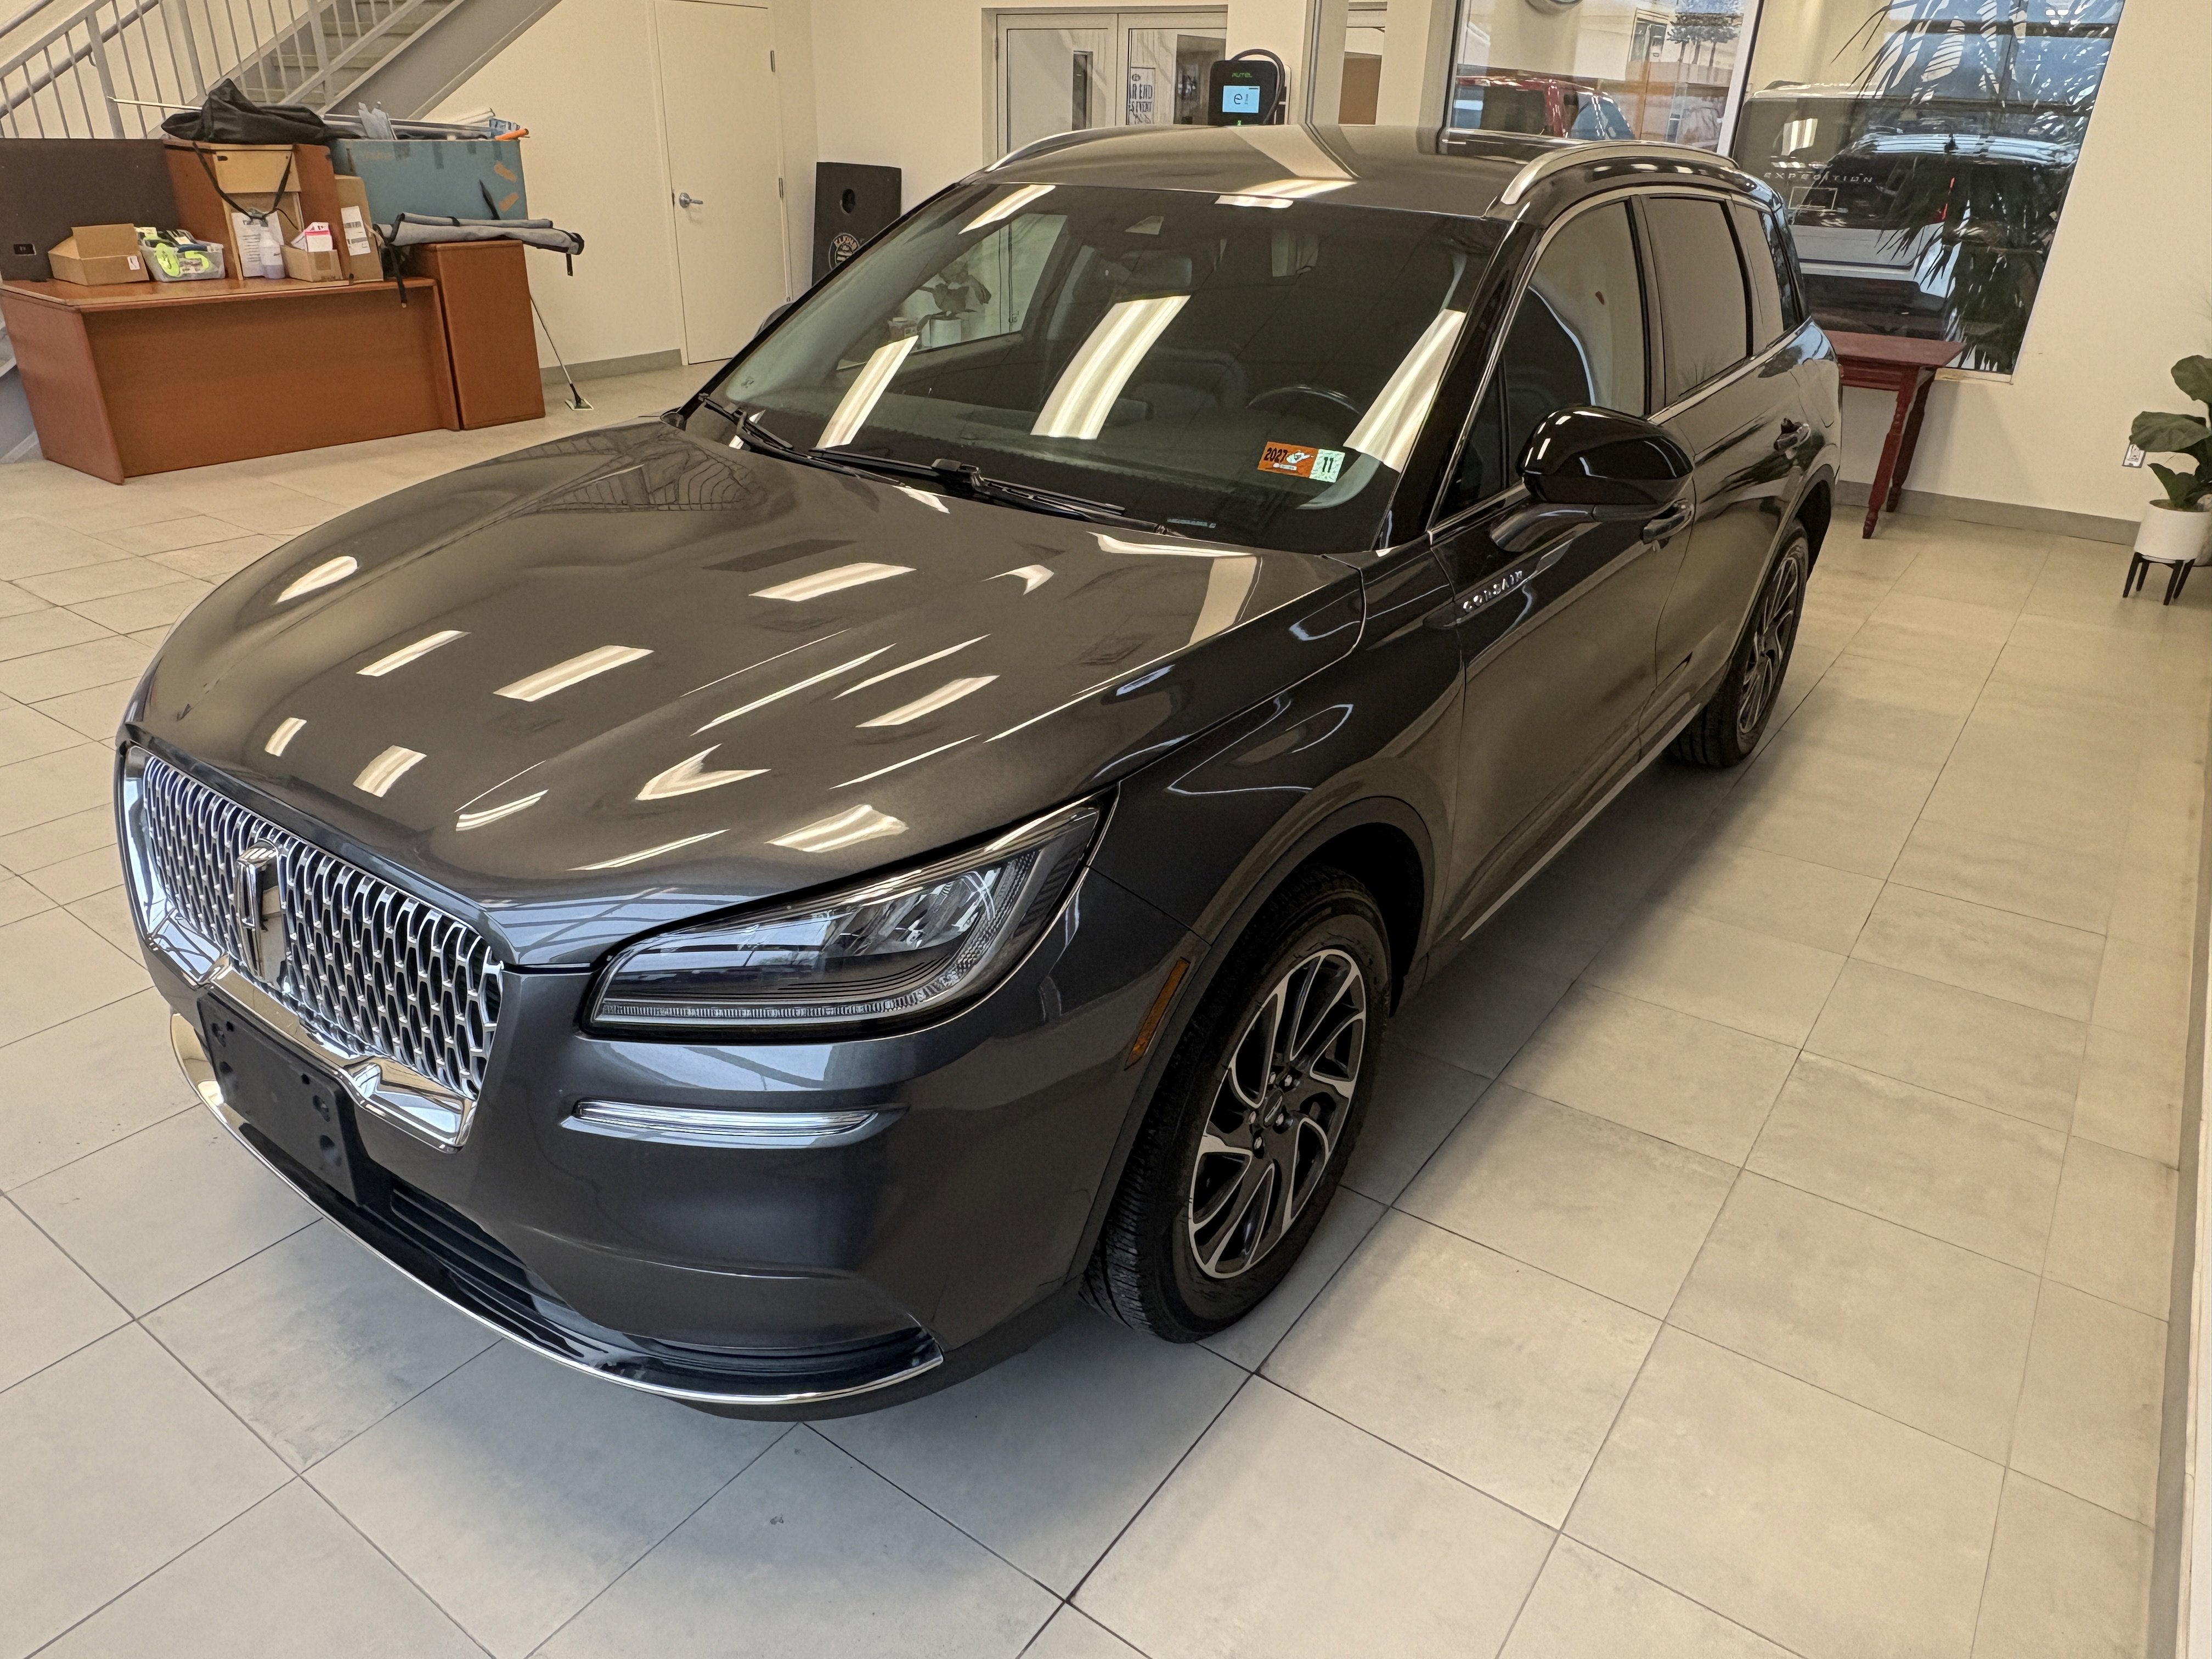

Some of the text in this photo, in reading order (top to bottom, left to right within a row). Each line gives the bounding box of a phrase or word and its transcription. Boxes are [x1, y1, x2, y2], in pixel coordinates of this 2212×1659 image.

[1263, 447, 1288, 463] 2027
[1322, 456, 1334, 473] 11
[1463, 570, 1523, 613] CORSAIR
